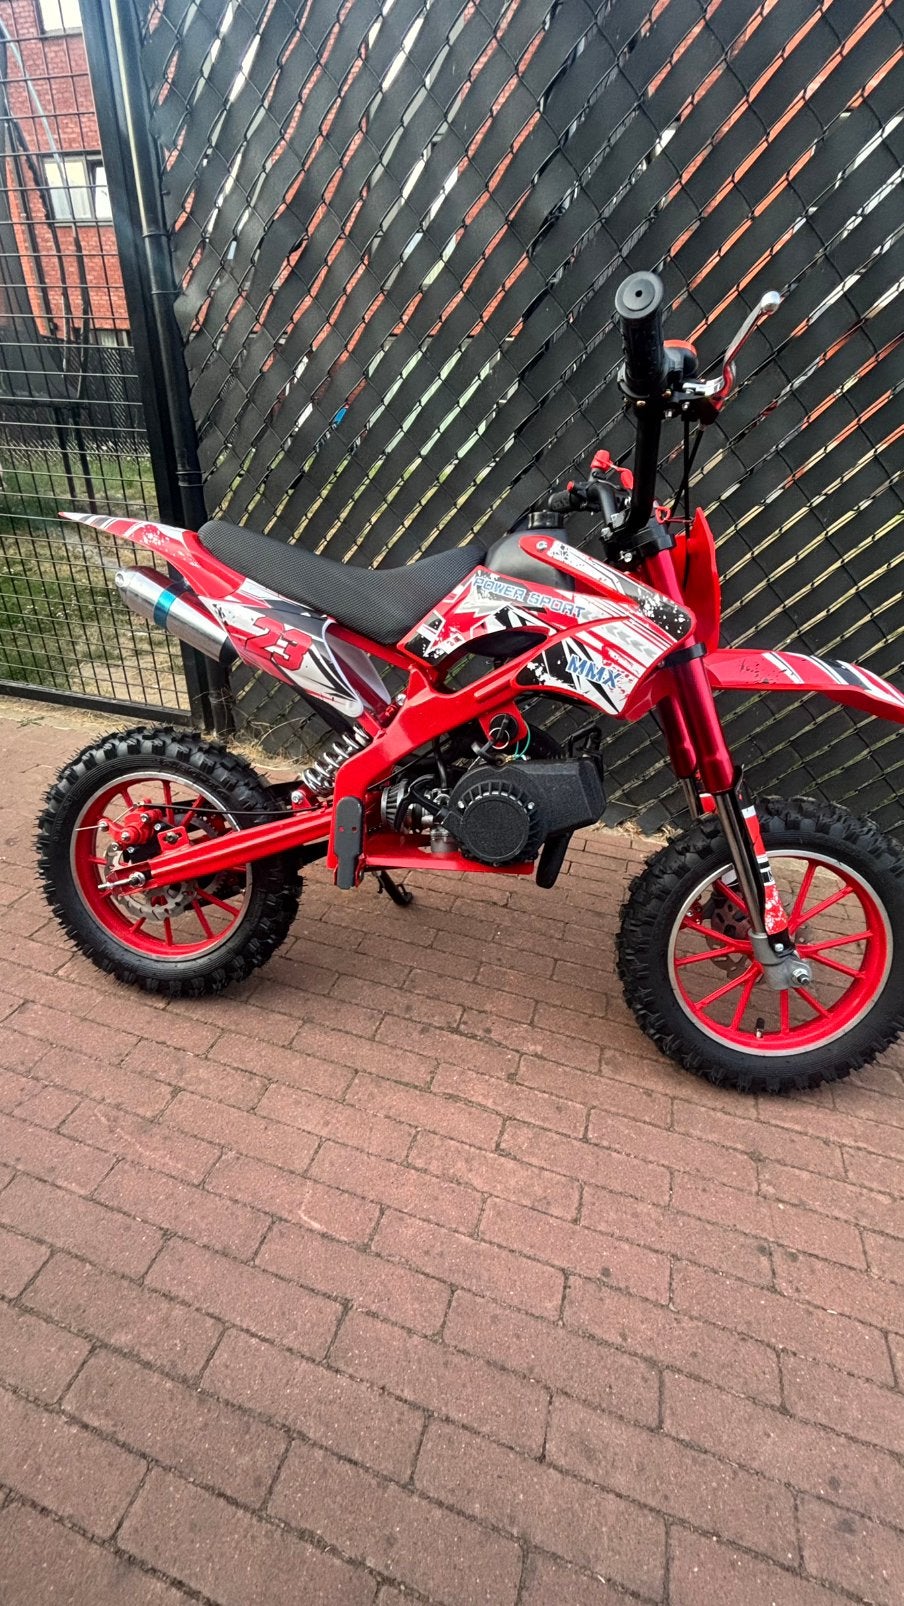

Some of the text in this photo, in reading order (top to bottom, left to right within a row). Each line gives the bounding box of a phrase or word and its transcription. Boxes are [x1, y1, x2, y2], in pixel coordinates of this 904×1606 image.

[472, 577, 586, 618] POWER SPORT
[245, 616, 313, 671] 23
[565, 653, 622, 689] MMX
